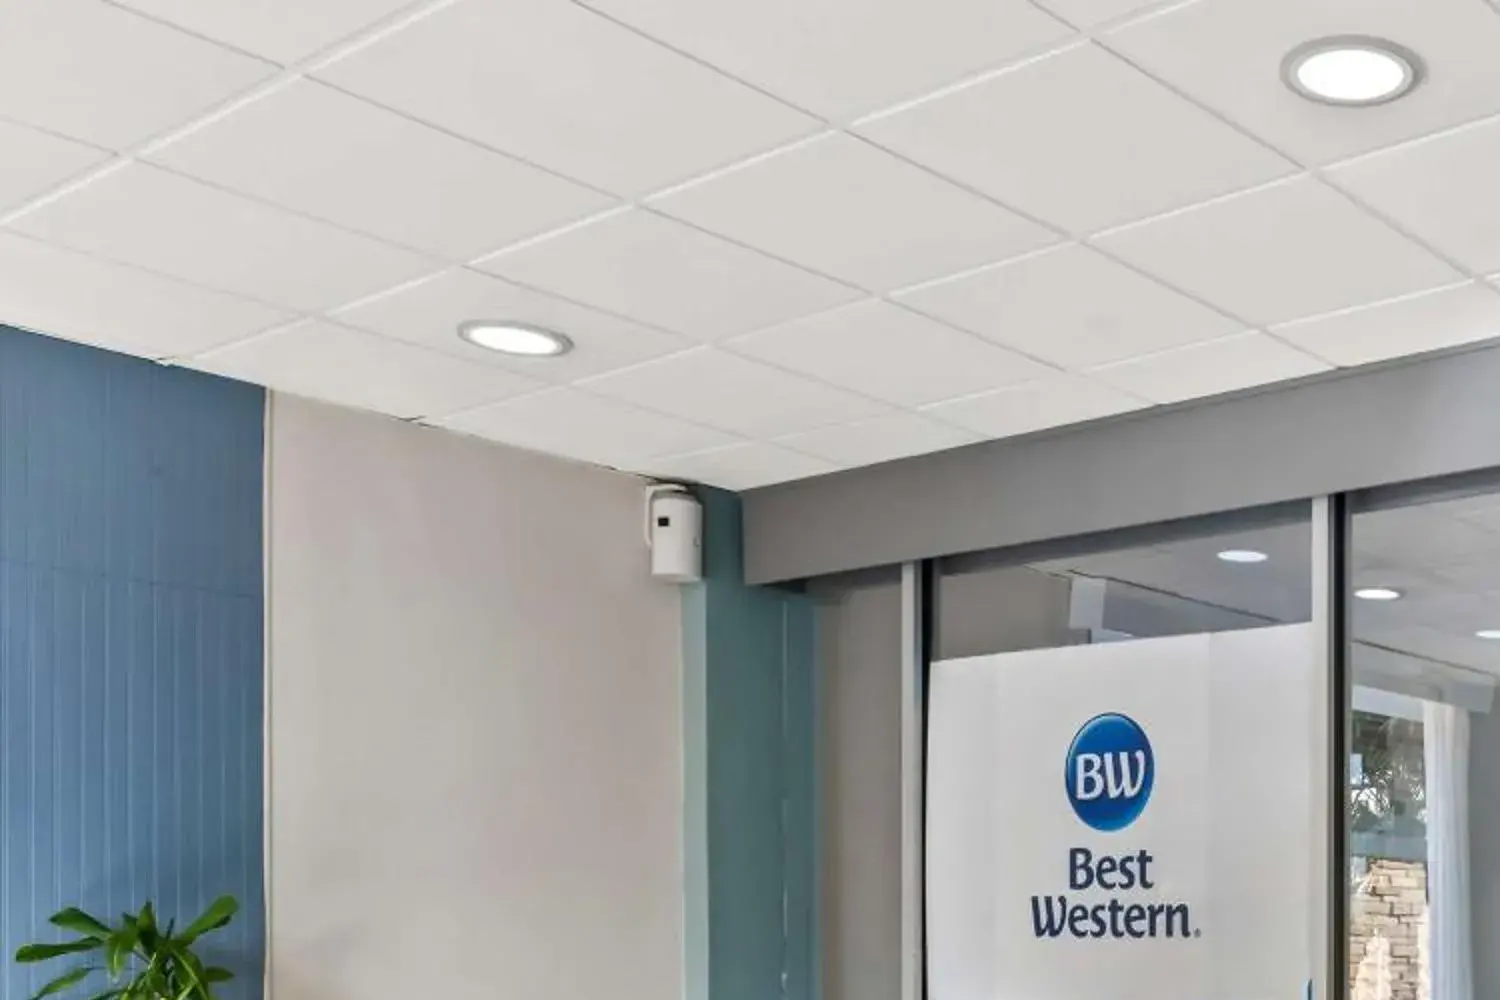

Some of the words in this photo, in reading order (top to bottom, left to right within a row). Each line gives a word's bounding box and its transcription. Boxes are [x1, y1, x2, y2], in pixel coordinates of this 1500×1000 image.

[1075, 750, 1146, 800] BW
[1068, 847, 1154, 890] Best
[1031, 895, 1190, 939] Western
